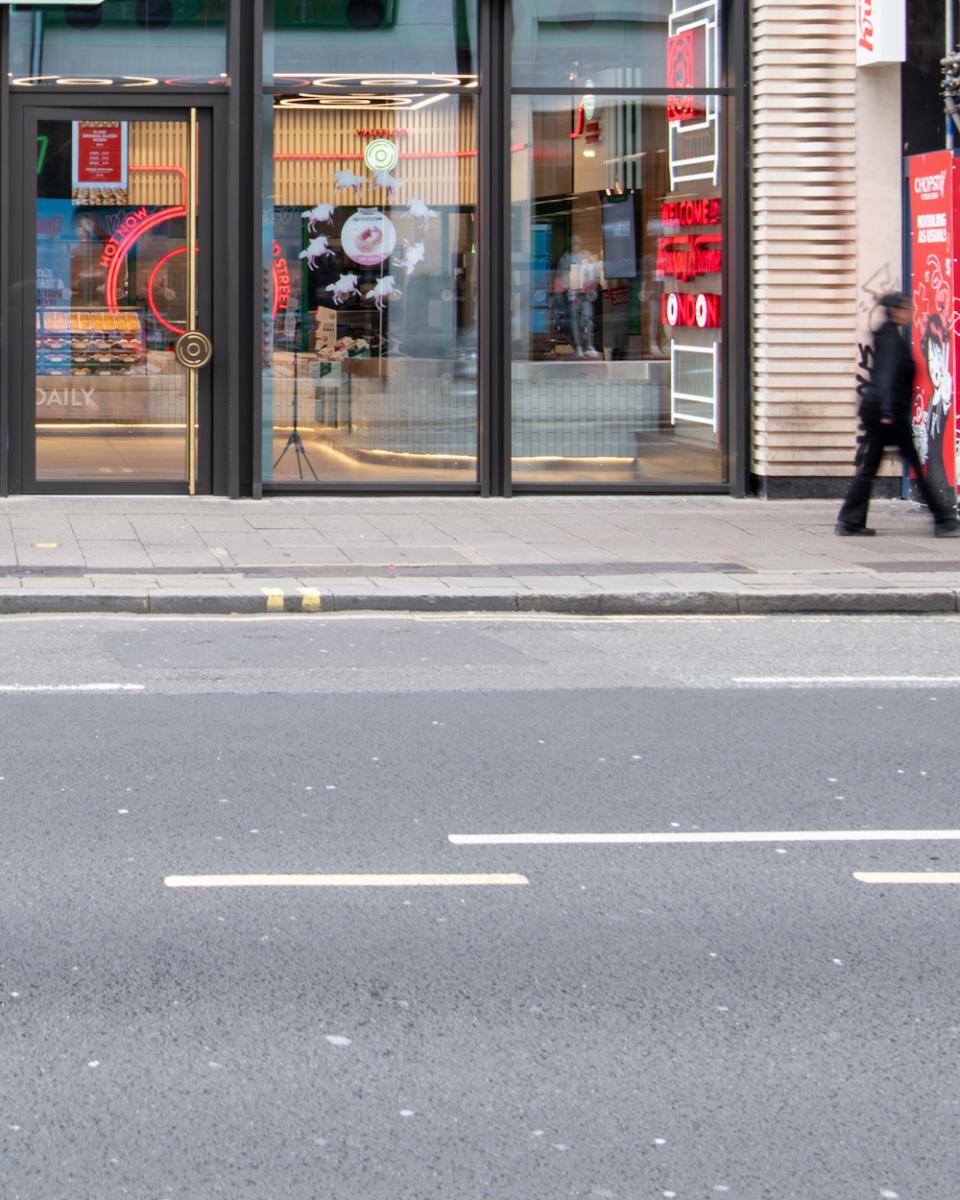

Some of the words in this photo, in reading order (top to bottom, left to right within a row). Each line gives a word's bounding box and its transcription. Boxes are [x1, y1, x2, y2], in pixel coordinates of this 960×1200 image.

[660, 199, 708, 226] WELCOME
[99, 235, 119, 267] HOT
[116, 206, 148, 237] NOW
[661, 293, 718, 327] LONDON
